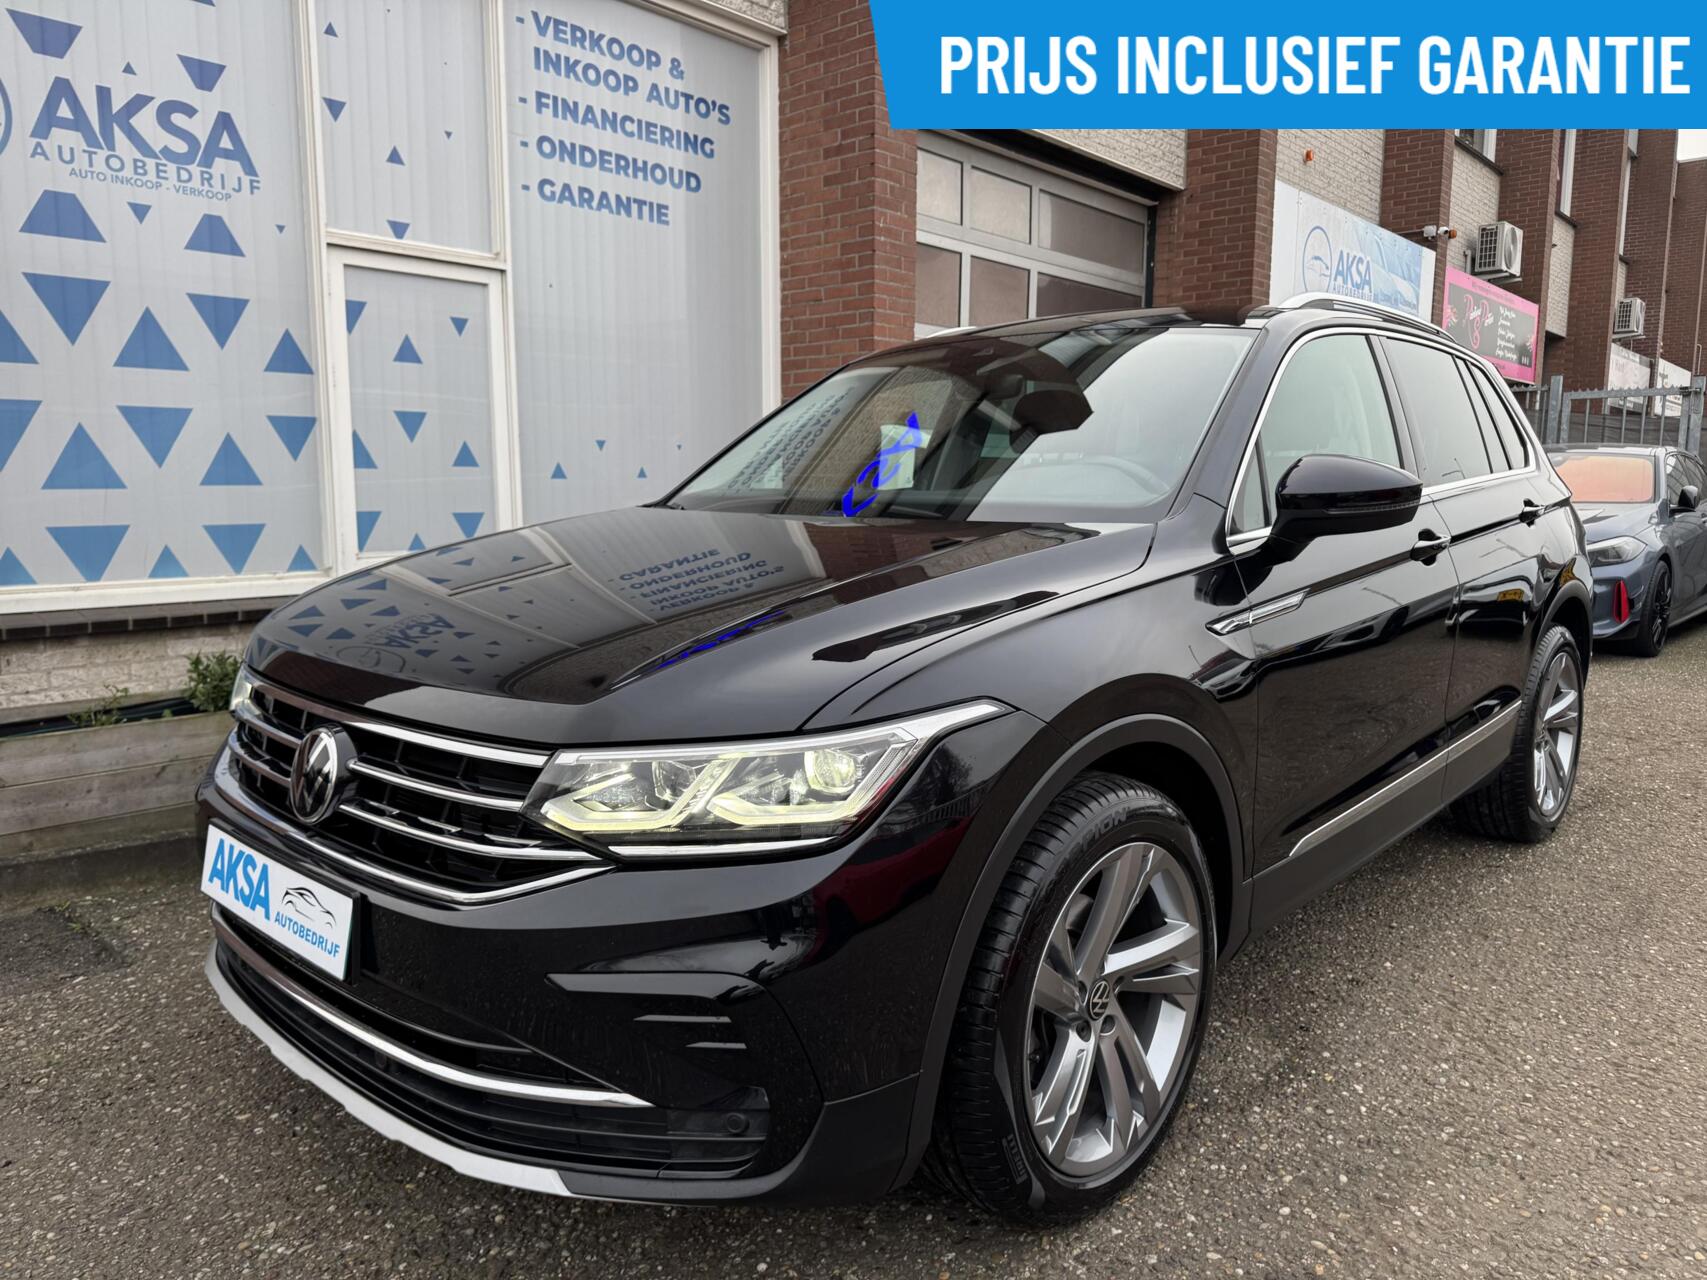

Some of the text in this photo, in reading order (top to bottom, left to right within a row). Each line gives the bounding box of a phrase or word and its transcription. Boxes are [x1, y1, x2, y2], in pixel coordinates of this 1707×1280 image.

[531, 10, 662, 71] VERKOOP
[668, 57, 685, 81] &
[534, 46, 731, 126] INKOOP AUTO'S
[29, 76, 260, 178] AKSA
[535, 91, 715, 159] FINANCIERING
[30, 141, 261, 195] AUTOBEDRIJF
[69, 167, 107, 183] AUTO
[110, 174, 162, 191] INKOOP
[173, 184, 232, 201] VERKOOP
[536, 135, 702, 193] ONDERHOUD
[537, 178, 670, 226] GARANTIE
[1333, 249, 1372, 293] AKSA
[208, 838, 271, 921] AKSA
[274, 911, 340, 958] AUTOBEDRIJF
